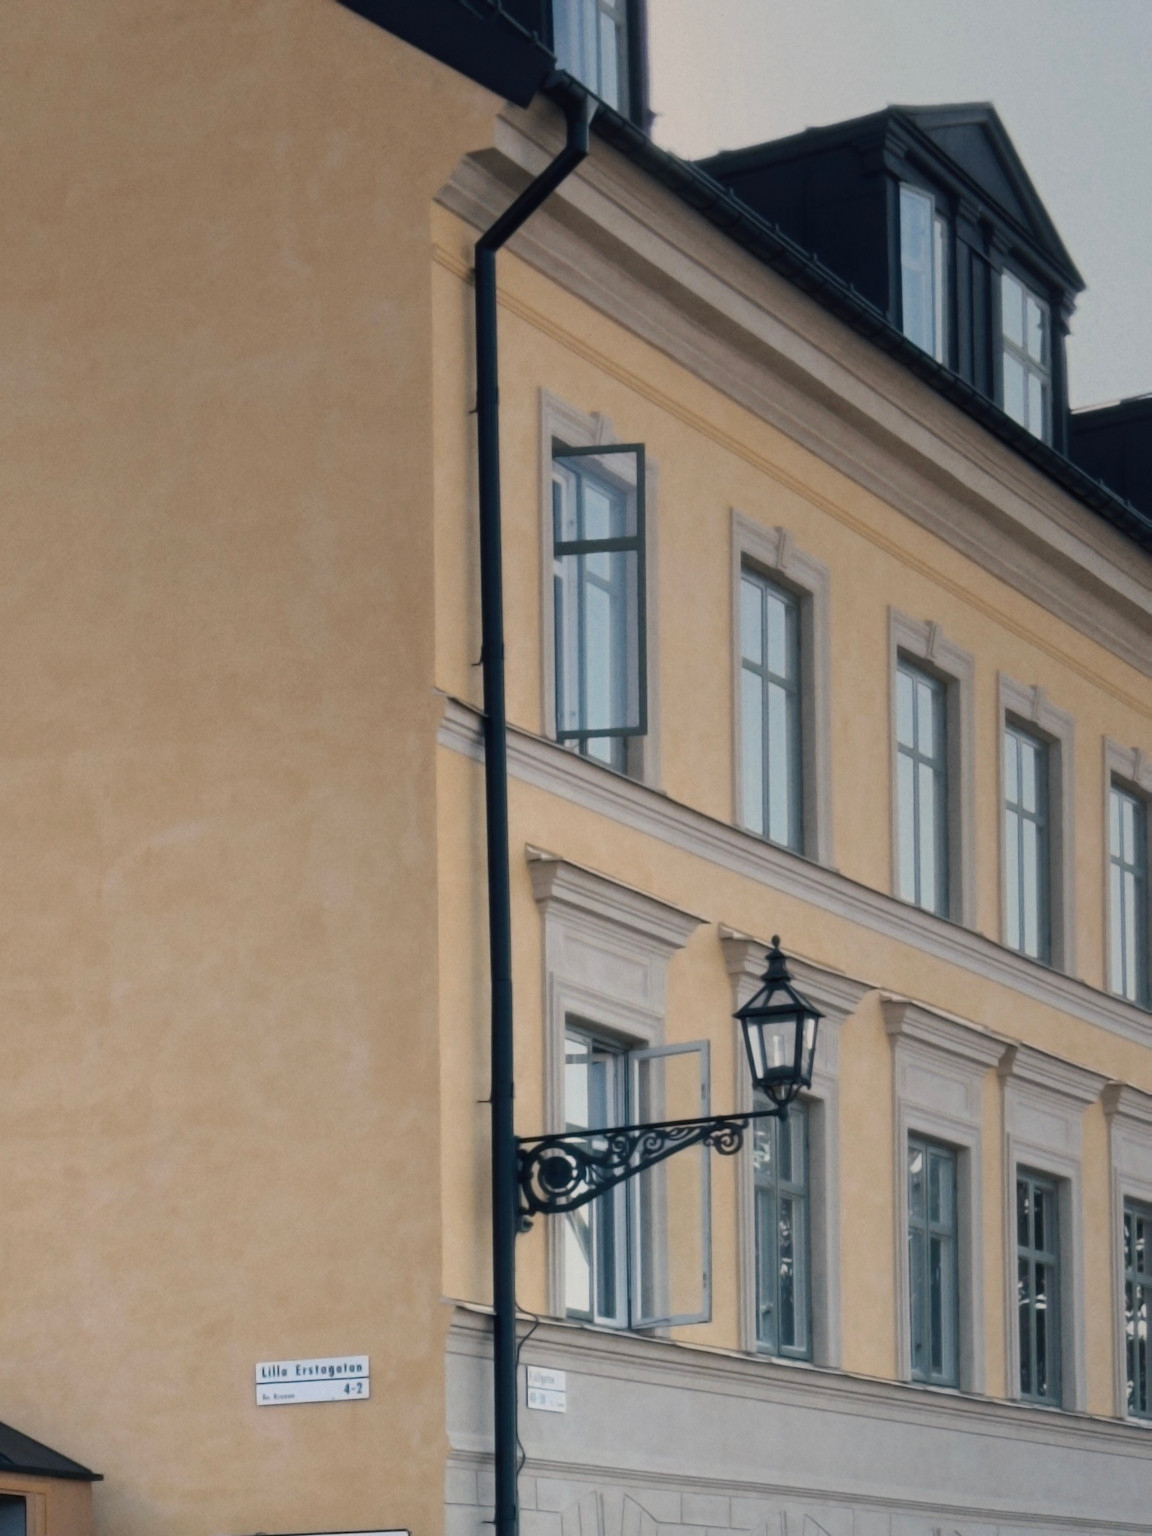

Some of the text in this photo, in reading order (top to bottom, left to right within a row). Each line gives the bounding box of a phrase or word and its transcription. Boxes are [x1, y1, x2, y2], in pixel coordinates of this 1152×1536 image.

[261, 1363, 363, 1378] Lilla Erstagatan
[344, 1382, 363, 1395] 4-2
